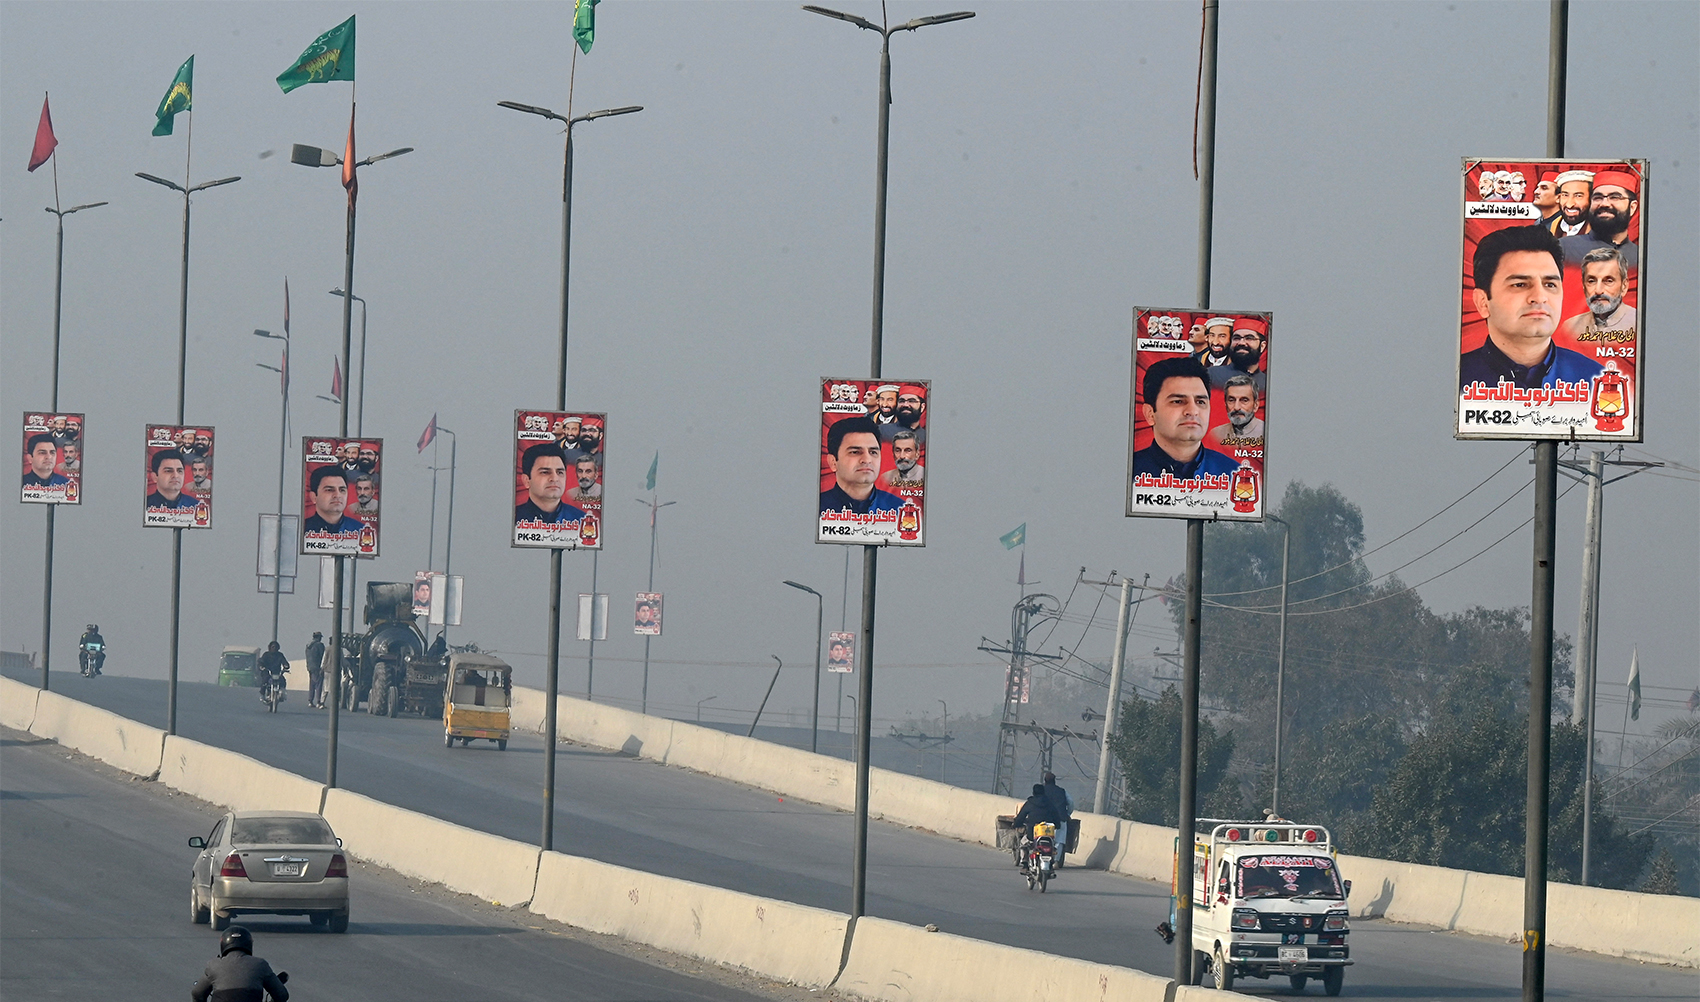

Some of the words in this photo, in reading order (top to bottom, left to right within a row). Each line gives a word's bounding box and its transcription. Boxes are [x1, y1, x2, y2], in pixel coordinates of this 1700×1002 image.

[1596, 347, 1635, 358] NA-32
[1465, 410, 1511, 424] PK-82
[1234, 450, 1263, 458] NA-32
[1136, 494, 1171, 505] PK-82
[822, 526, 850, 534] PK-82
